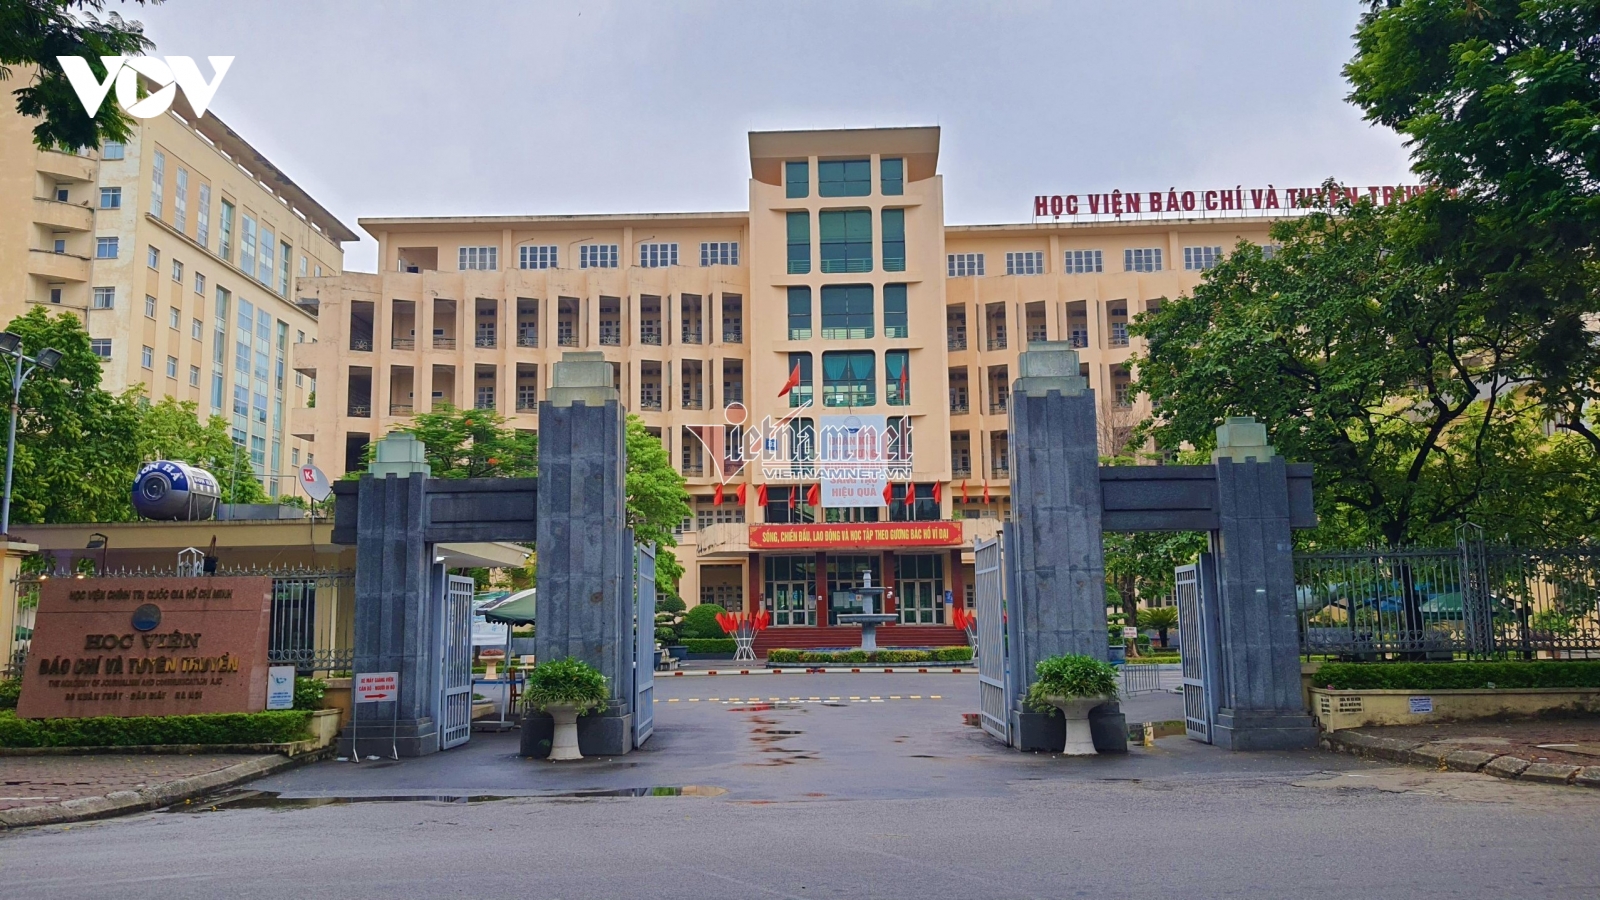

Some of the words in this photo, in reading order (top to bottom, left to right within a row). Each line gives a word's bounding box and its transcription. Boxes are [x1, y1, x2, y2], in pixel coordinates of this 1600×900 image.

[1035, 195, 1078, 219] HỌC
[1087, 189, 1140, 217] VIỆN
[1149, 187, 1195, 213] BÁO
[1205, 184, 1243, 211] CHÍ
[1251, 184, 1279, 209] VÀ
[832, 486, 854, 498] HIỆU
[857, 484, 877, 497] QUẢ
[762, 528, 780, 543] SỐNG,
[781, 527, 798, 542] CHIẾN
[798, 528, 812, 542] ĐẤU,
[813, 531, 824, 541] LAO
[825, 528, 841, 543] ĐỘNG
[842, 528, 849, 541] VÀ
[850, 530, 862, 543] HỌC
[863, 527, 873, 543] TẬP
[874, 529, 889, 540] THEO
[890, 528, 909, 540] GƯƠNG
[910, 527, 922, 540] BÁC
[922, 526, 931, 539] HỒ
[932, 526, 939, 539] VĨ
[939, 528, 949, 541] ĐẠI
[85, 634, 135, 652] HỌC
[142, 631, 202, 652] VIỆN
[38, 655, 72, 675] BÁO
[74, 655, 103, 675] CHÍ
[105, 655, 124, 674] VÀ
[129, 655, 178, 674] TUYÊN
